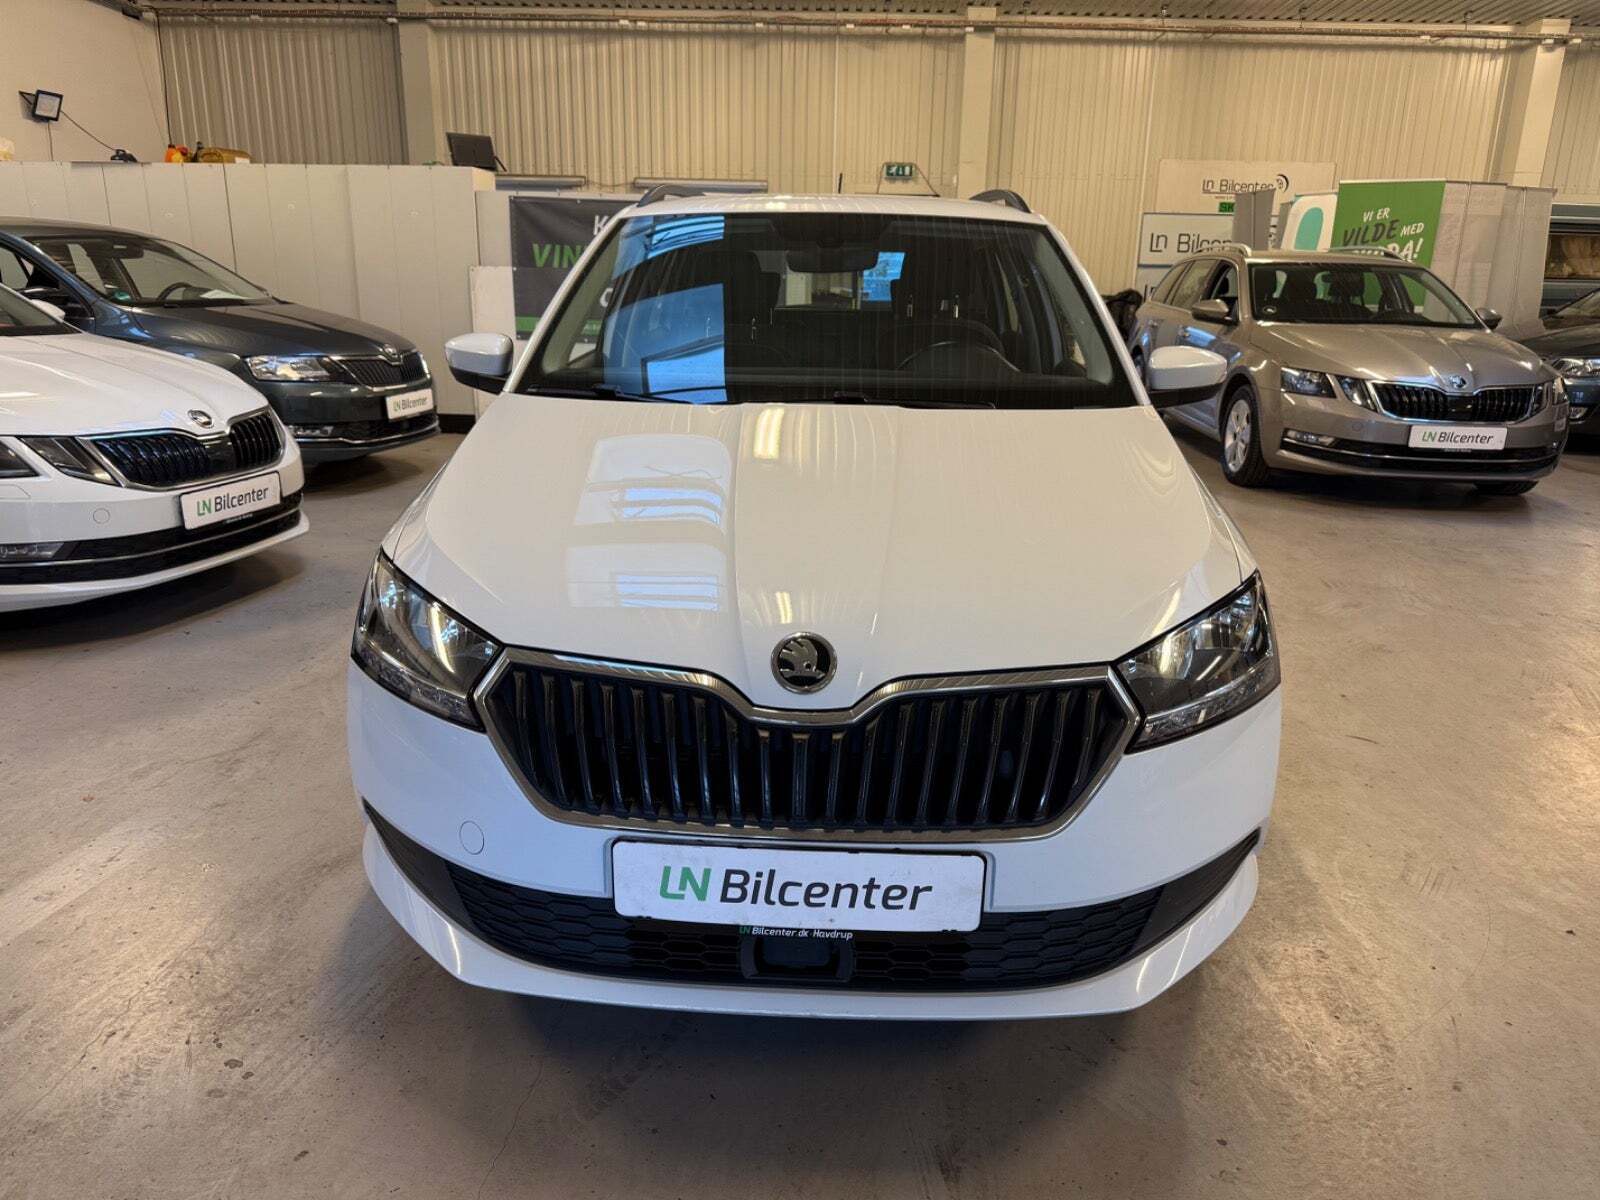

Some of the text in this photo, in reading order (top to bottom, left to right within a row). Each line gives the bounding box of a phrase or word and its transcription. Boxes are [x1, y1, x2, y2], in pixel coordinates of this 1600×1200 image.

[1363, 207, 1390, 223] VI ER
[1343, 219, 1424, 247] VILDE MED
[1422, 431, 1494, 444] LN Bilcenter
[197, 487, 269, 516] LN Bilcenter
[659, 865, 933, 911] LN Bilcenter
